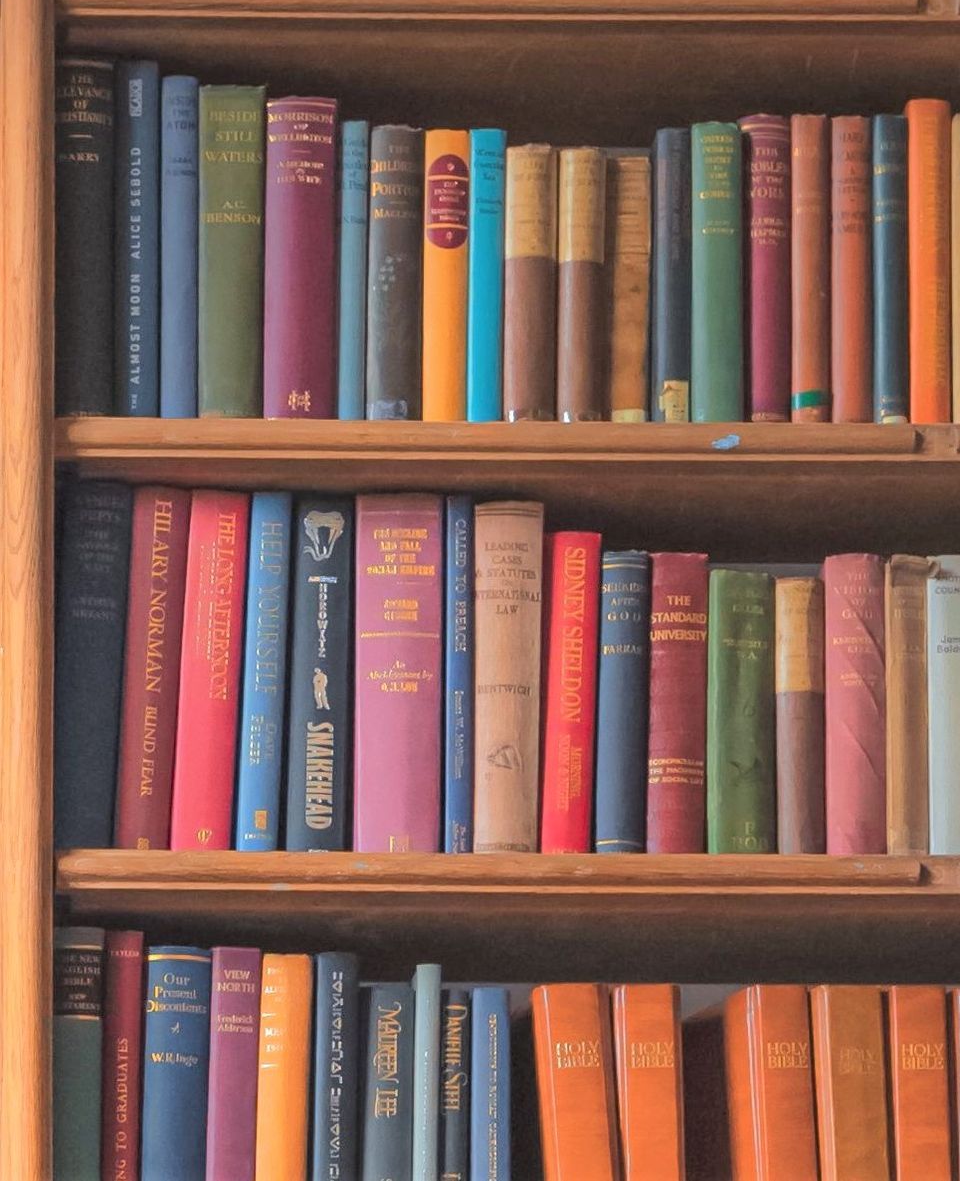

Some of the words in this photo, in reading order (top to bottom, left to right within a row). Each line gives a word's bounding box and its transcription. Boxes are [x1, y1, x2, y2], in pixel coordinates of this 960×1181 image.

[268, 111, 334, 124] MORRISON
[204, 149, 263, 164] WATERS
[130, 146, 142, 209] SEBOLD
[204, 211, 262, 225] BENSON
[130, 214, 141, 260] ALICE
[130, 273, 141, 317] MOON
[130, 323, 141, 384] ALMOST
[218, 512, 237, 547] THE
[154, 499, 174, 583] HILARY
[259, 521, 284, 571] HELP
[455, 519, 467, 567] CALLED
[484, 541, 529, 552] LEADING
[491, 555, 523, 565] CASES
[486, 569, 537, 580] STATUTES
[455, 575, 466, 594] TO
[564, 546, 586, 621] SIDNEY
[667, 595, 692, 606] THE
[495, 604, 519, 616] LAW
[651, 613, 707, 625] STANDARD
[455, 602, 467, 653] PREACH
[146, 587, 167, 695] NORMAN
[254, 585, 281, 696] YOURSELF
[650, 629, 708, 643] UNIVERSITY
[561, 624, 584, 724] SHELDON
[145, 705, 158, 754] BLIND
[140, 757, 156, 798] FEAR
[305, 721, 334, 830] SNAKEHEAD
[163, 972, 191, 986] Our
[223, 969, 250, 981] VIEW
[153, 986, 198, 1000] Present
[216, 981, 256, 994] NORTH
[445, 1002, 468, 1068] DANIELLE
[555, 1041, 600, 1056] HOLY
[630, 1041, 675, 1056] HOLY
[766, 1042, 809, 1056] HOLY
[901, 1043, 944, 1057] HOLY
[556, 1055, 600, 1069] BIBLE
[630, 1055, 675, 1069] BIBLE
[767, 1056, 809, 1069] BIBLE
[901, 1057, 945, 1070] BIBLE
[116, 1037, 129, 1124] GRADUATES
[444, 1068, 469, 1112] STEEL
[115, 1130, 128, 1153] TO
